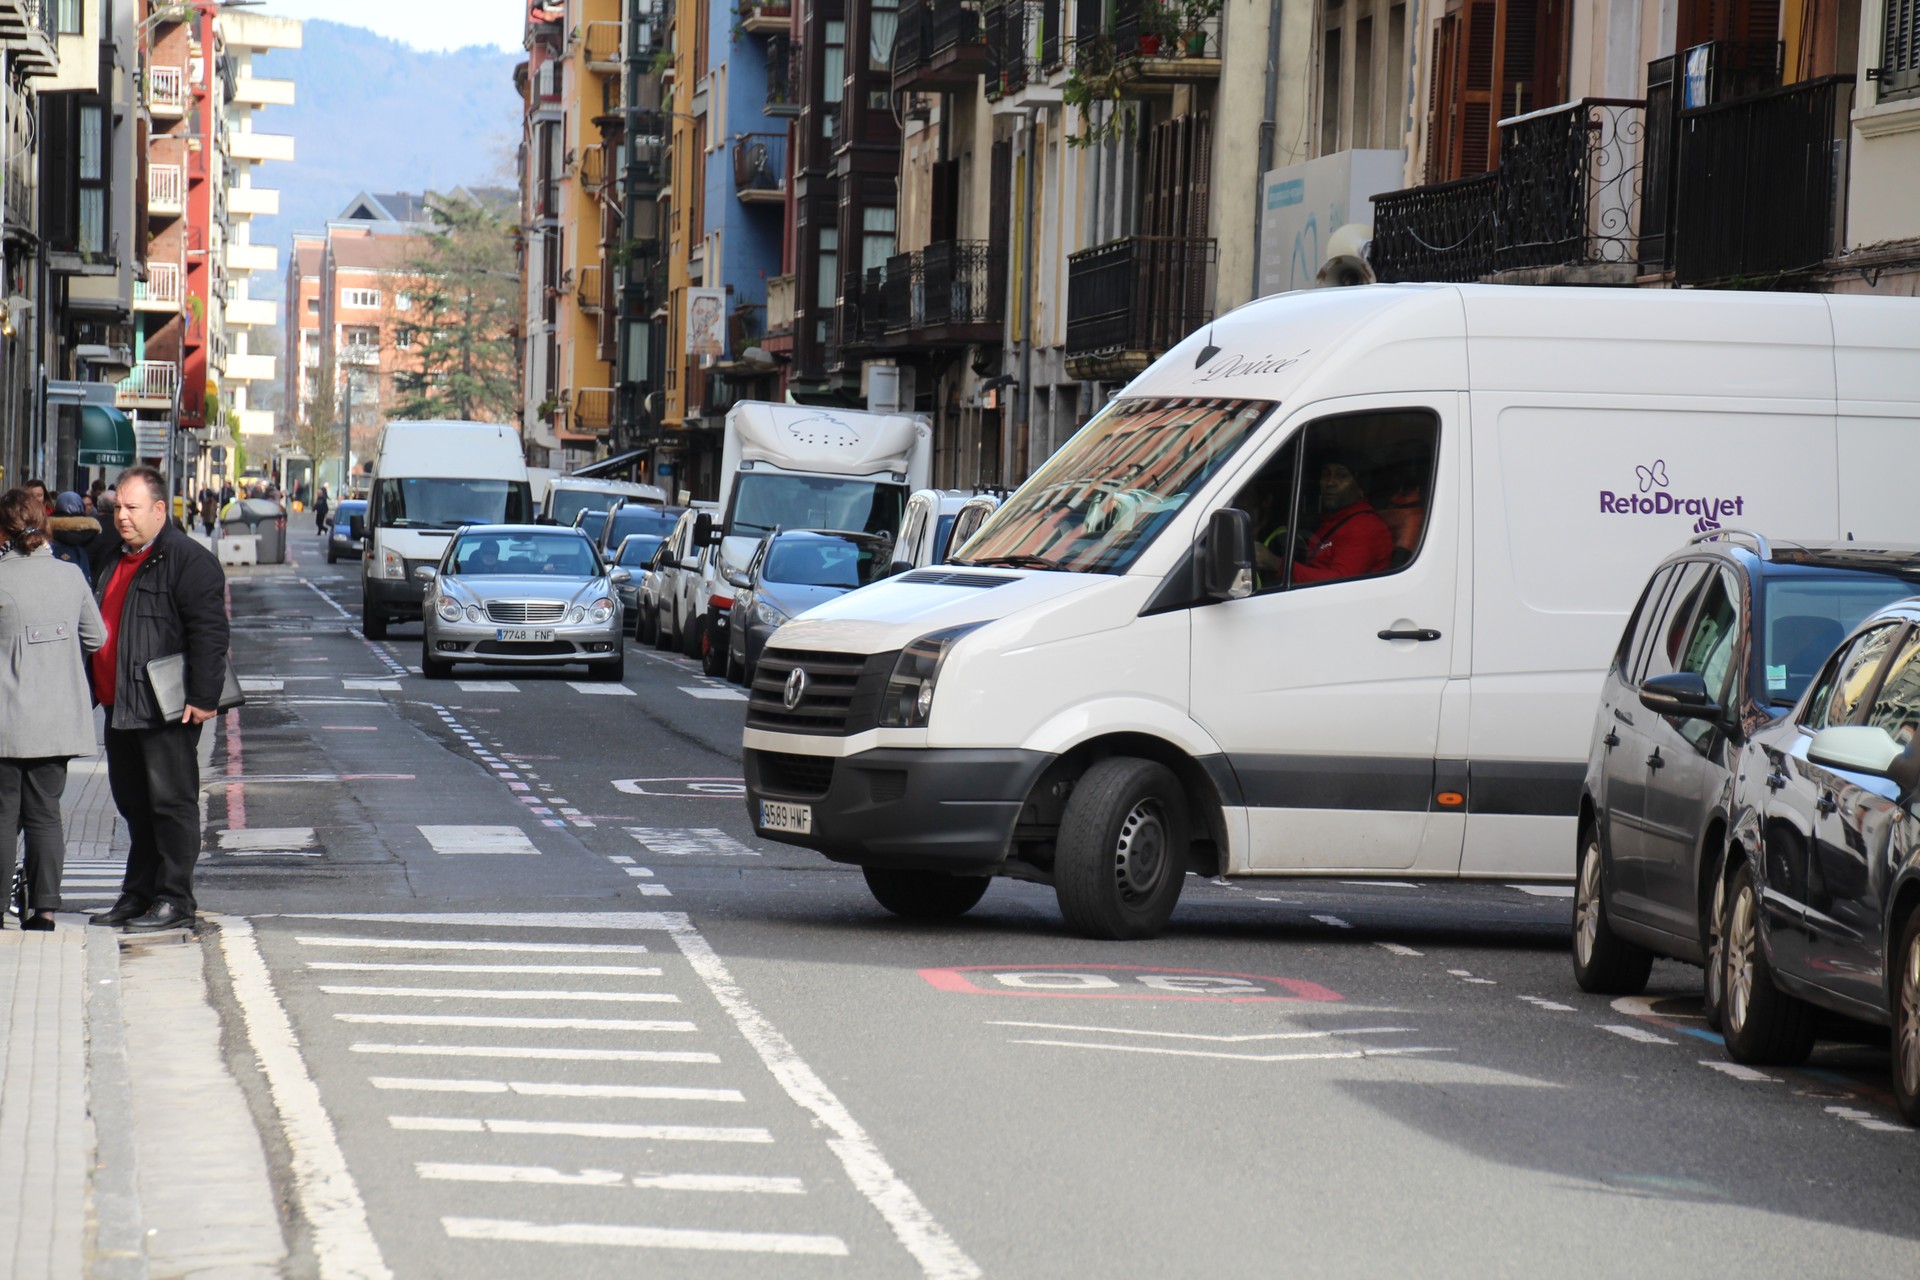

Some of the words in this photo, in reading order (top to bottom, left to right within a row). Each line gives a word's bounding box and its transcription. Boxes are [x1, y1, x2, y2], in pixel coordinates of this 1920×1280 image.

[1600, 490, 1744, 521] RetoDravet
[502, 630, 527, 640] 7748
[534, 630, 553, 640] FNF
[765, 803, 788, 827] 9589
